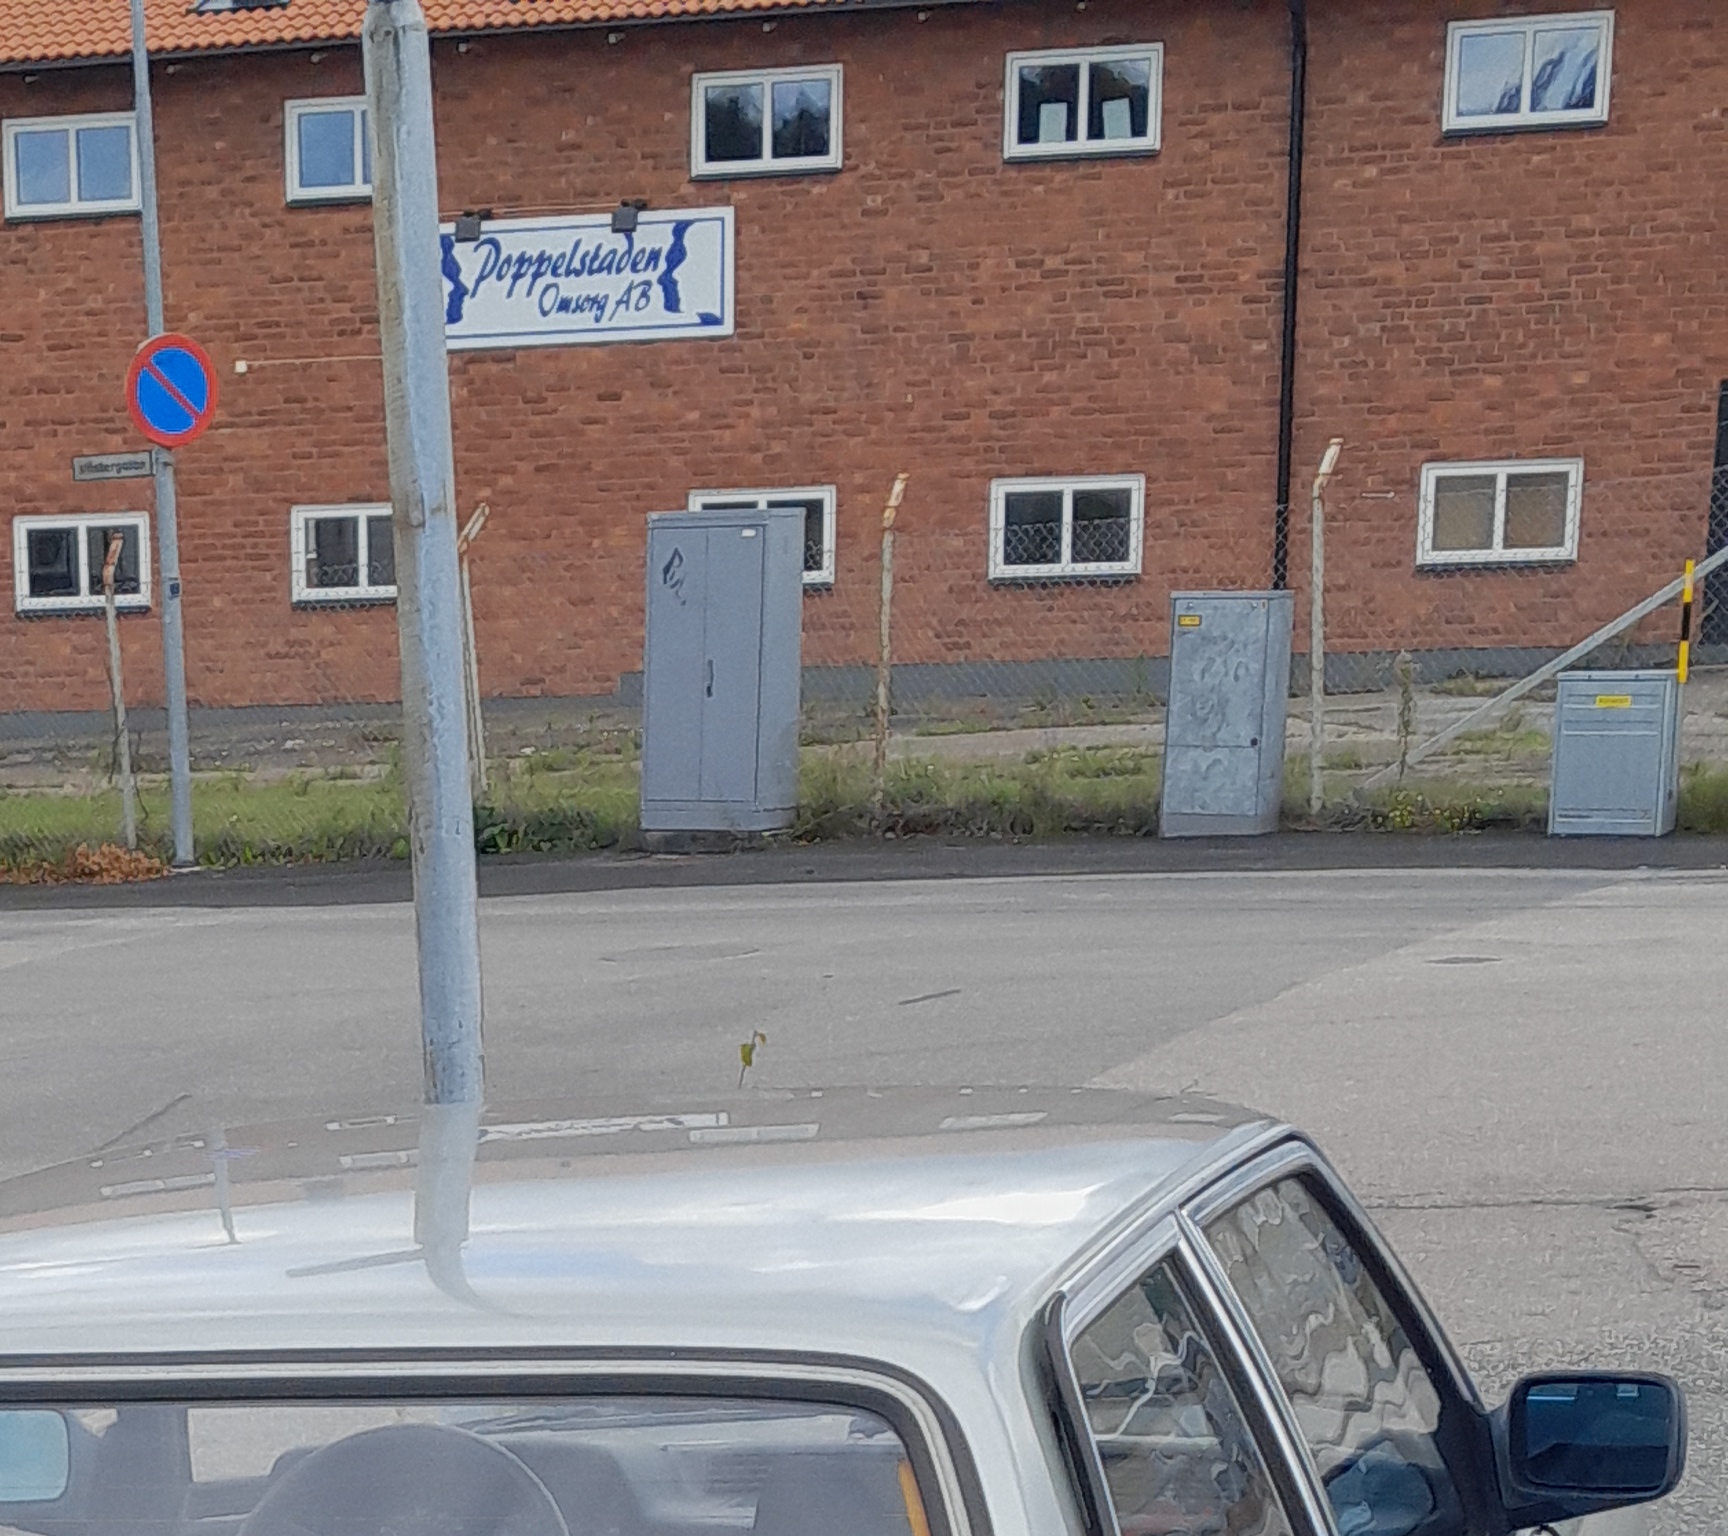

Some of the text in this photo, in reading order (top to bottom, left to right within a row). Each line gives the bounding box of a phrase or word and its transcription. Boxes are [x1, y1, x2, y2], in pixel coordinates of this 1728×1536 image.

[470, 232, 663, 299] Poppelstaden
[538, 279, 653, 323] Omsorg AB
